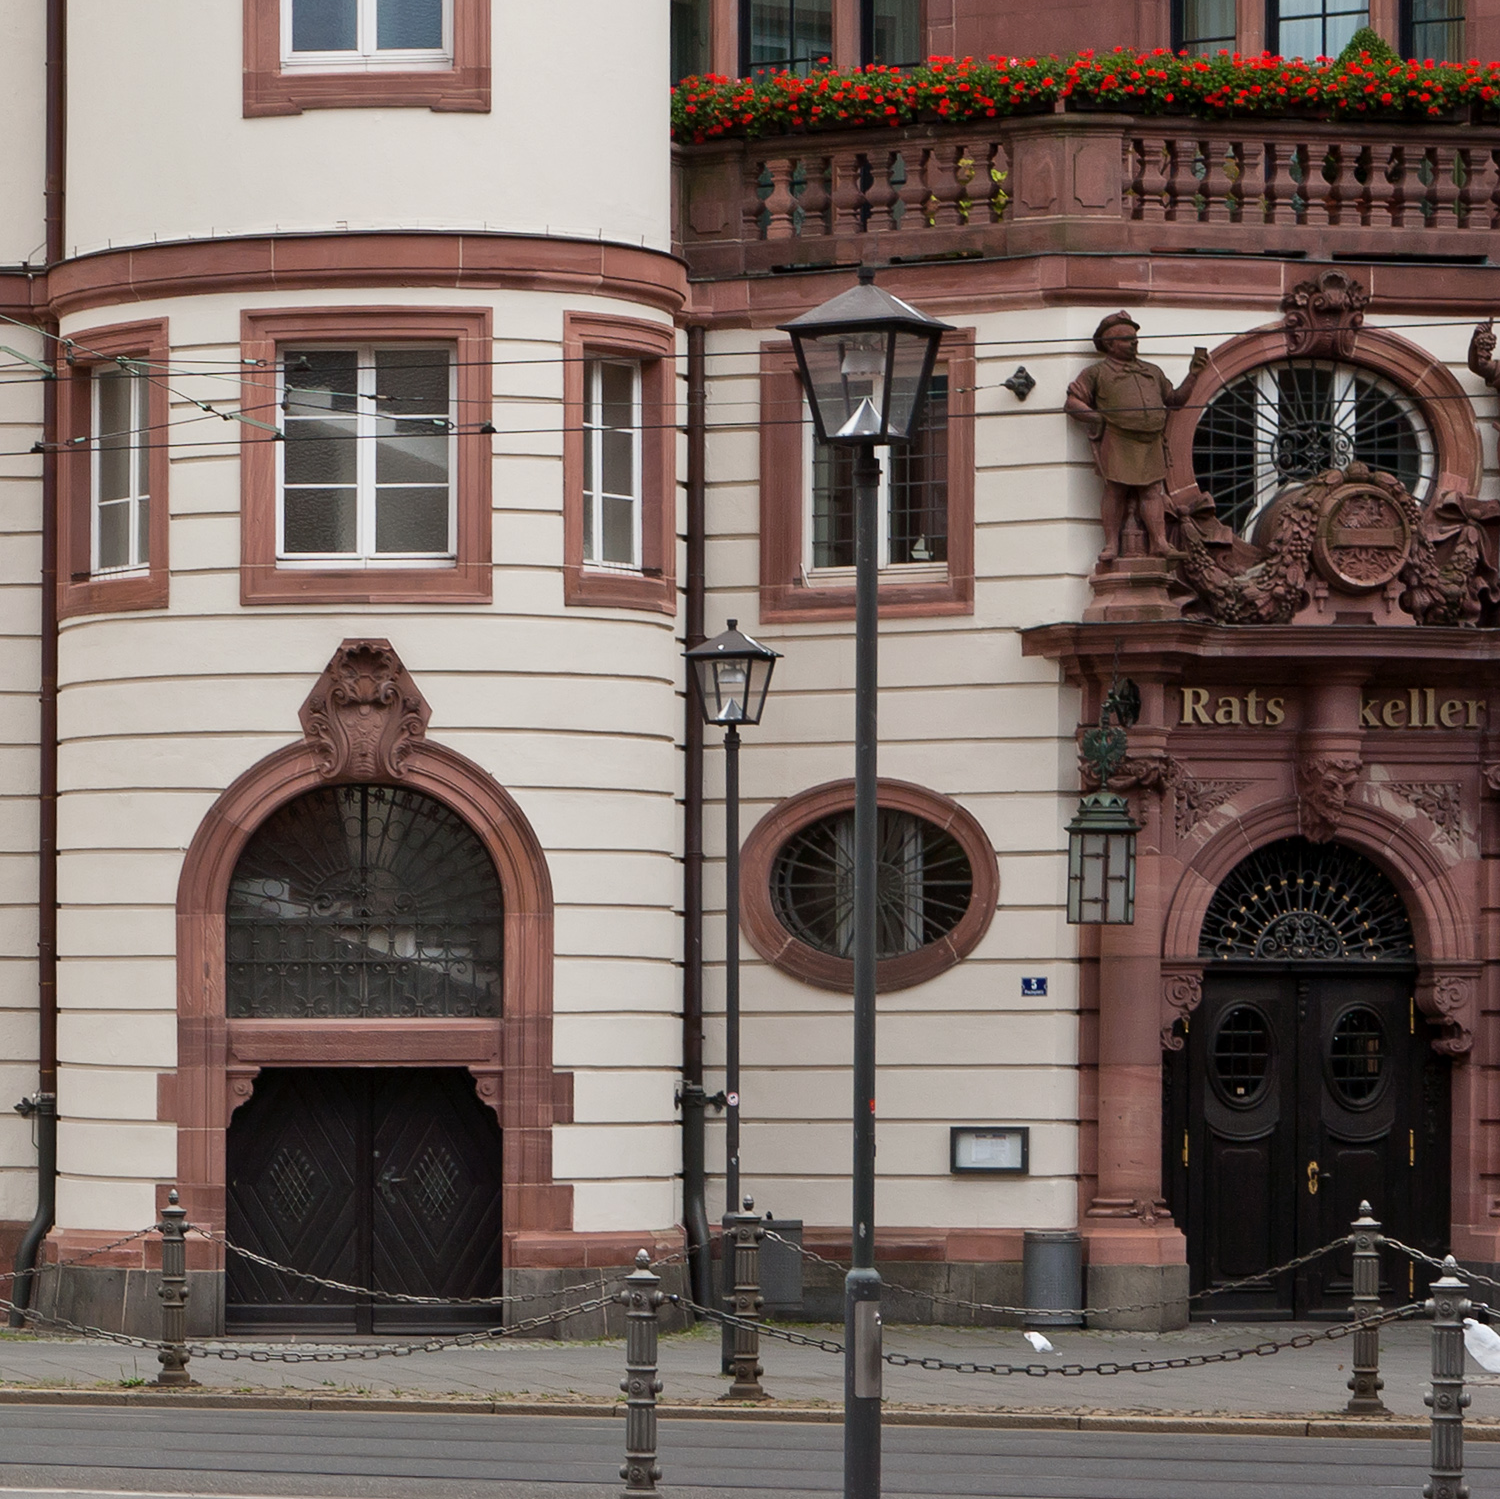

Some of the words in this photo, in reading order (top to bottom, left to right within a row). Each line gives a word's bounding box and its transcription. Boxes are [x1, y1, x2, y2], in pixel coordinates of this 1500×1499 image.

[1180, 687, 1285, 726] Rats
[1358, 687, 1486, 728] keller
[1031, 978, 1038, 990] 5
